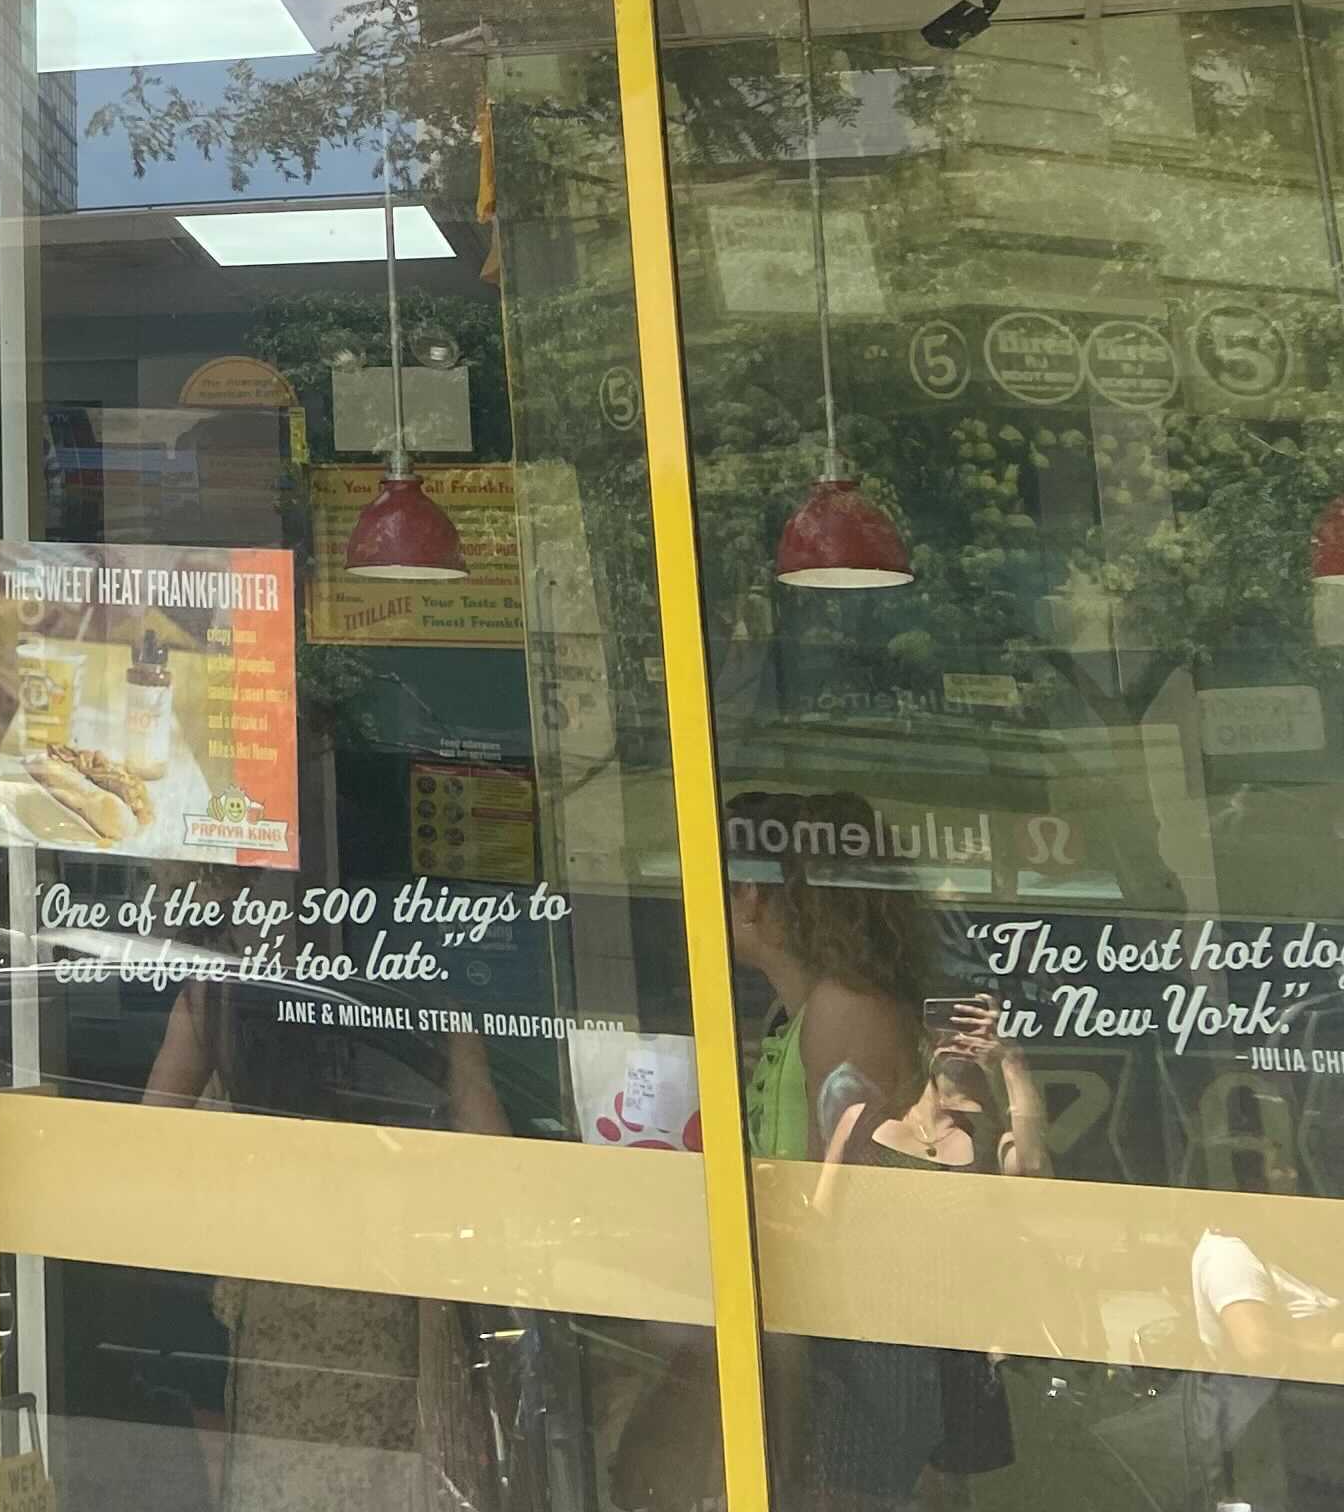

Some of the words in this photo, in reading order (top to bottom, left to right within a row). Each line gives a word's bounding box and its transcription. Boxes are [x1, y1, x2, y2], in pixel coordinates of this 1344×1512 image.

[2, 570, 30, 601] THE
[33, 564, 94, 604] SWEET
[98, 567, 143, 605] HEAT
[146, 568, 280, 613] FRANKFURTER
[343, 595, 414, 632] TITILLATE
[247, 824, 283, 842] KING
[117, 885, 159, 937] of
[163, 887, 225, 927] the
[230, 889, 294, 939] top
[297, 888, 378, 926] 500
[391, 875, 523, 944] things
[527, 880, 573, 922] to
[118, 945, 231, 992] before
[294, 943, 358, 981] too
[1096, 923, 1183, 974] best
[1189, 919, 1276, 971] hot
[1282, 921, 1344, 990] do
[277, 1000, 316, 1024] JANE
[320, 1002, 335, 1025] &
[338, 1004, 415, 1032] MICHAEL
[996, 999, 1043, 1040] in
[1049, 984, 1160, 1039] New
